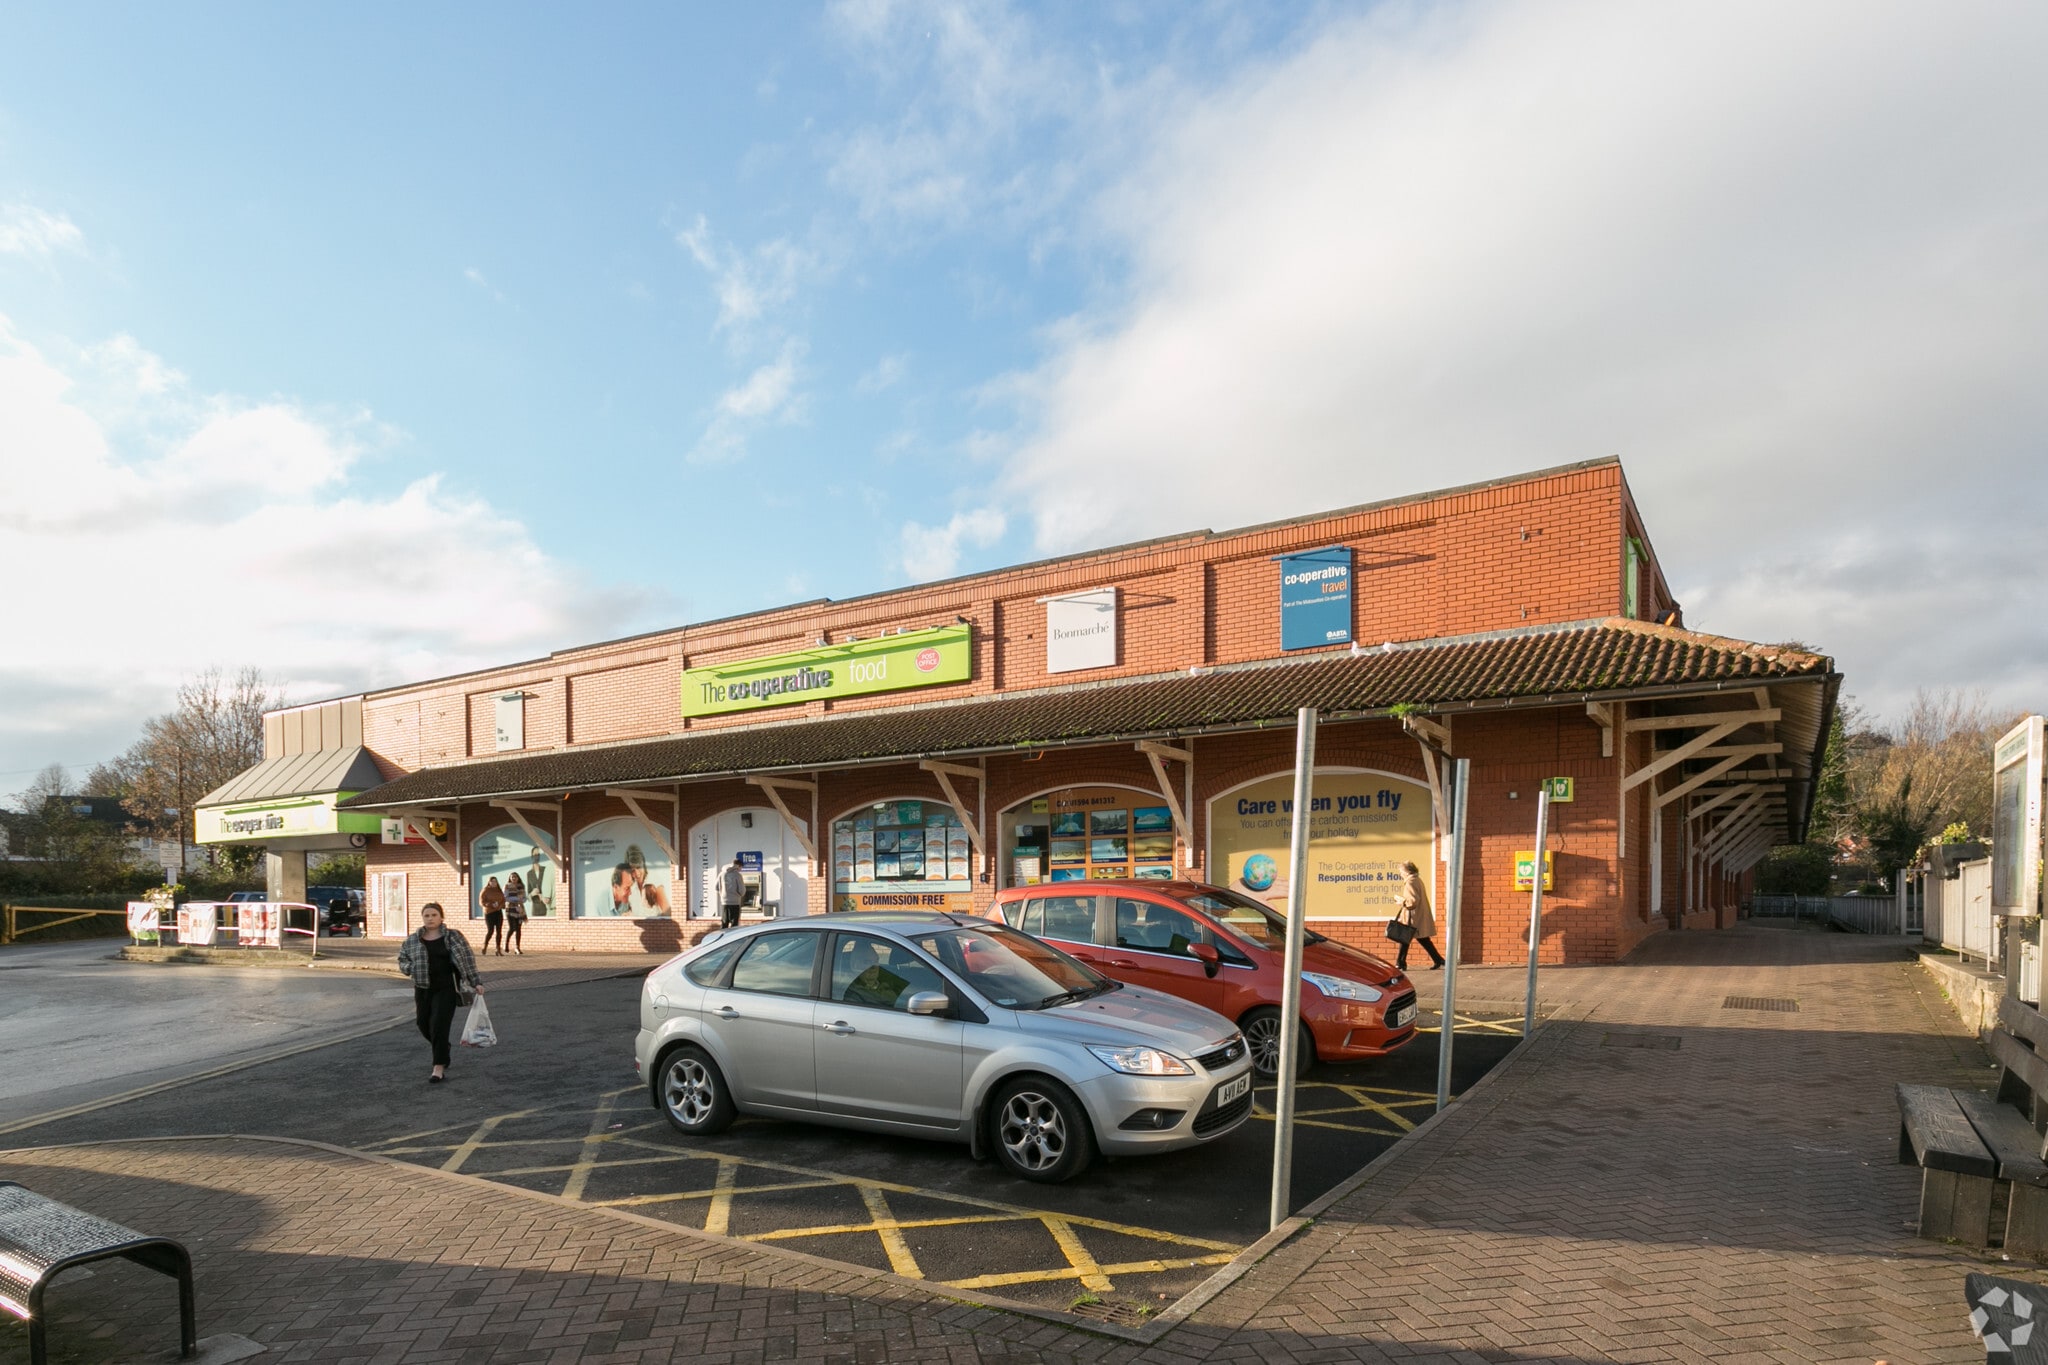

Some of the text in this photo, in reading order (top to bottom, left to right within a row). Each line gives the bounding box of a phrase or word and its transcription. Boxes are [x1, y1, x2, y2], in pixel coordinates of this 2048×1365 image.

[1285, 566, 1347, 585] co-operative
[1322, 578, 1347, 594] travel
[1053, 621, 1110, 640] Bonmarché
[921, 652, 936, 660] POST
[918, 659, 937, 667] OFFICE
[700, 655, 887, 704] The co-operative food
[1237, 789, 1402, 815] Care wen you fly
[219, 818, 232, 834] The
[1240, 819, 1256, 829] You
[1257, 819, 1273, 828] can
[1318, 814, 1349, 825] carbon
[1352, 812, 1398, 824] emissions
[1310, 830, 1325, 839] our
[1327, 827, 1359, 838] holiday
[1318, 861, 1333, 871] The
[1335, 861, 1386, 872] Co-operative
[1318, 872, 1374, 883] Responsible
[1376, 872, 1384, 881] &
[1346, 884, 1362, 893] and
[1363, 885, 1389, 895] caring
[862, 895, 919, 906] COMMISSION
[922, 894, 945, 905] FREE
[1363, 896, 1379, 905] and
